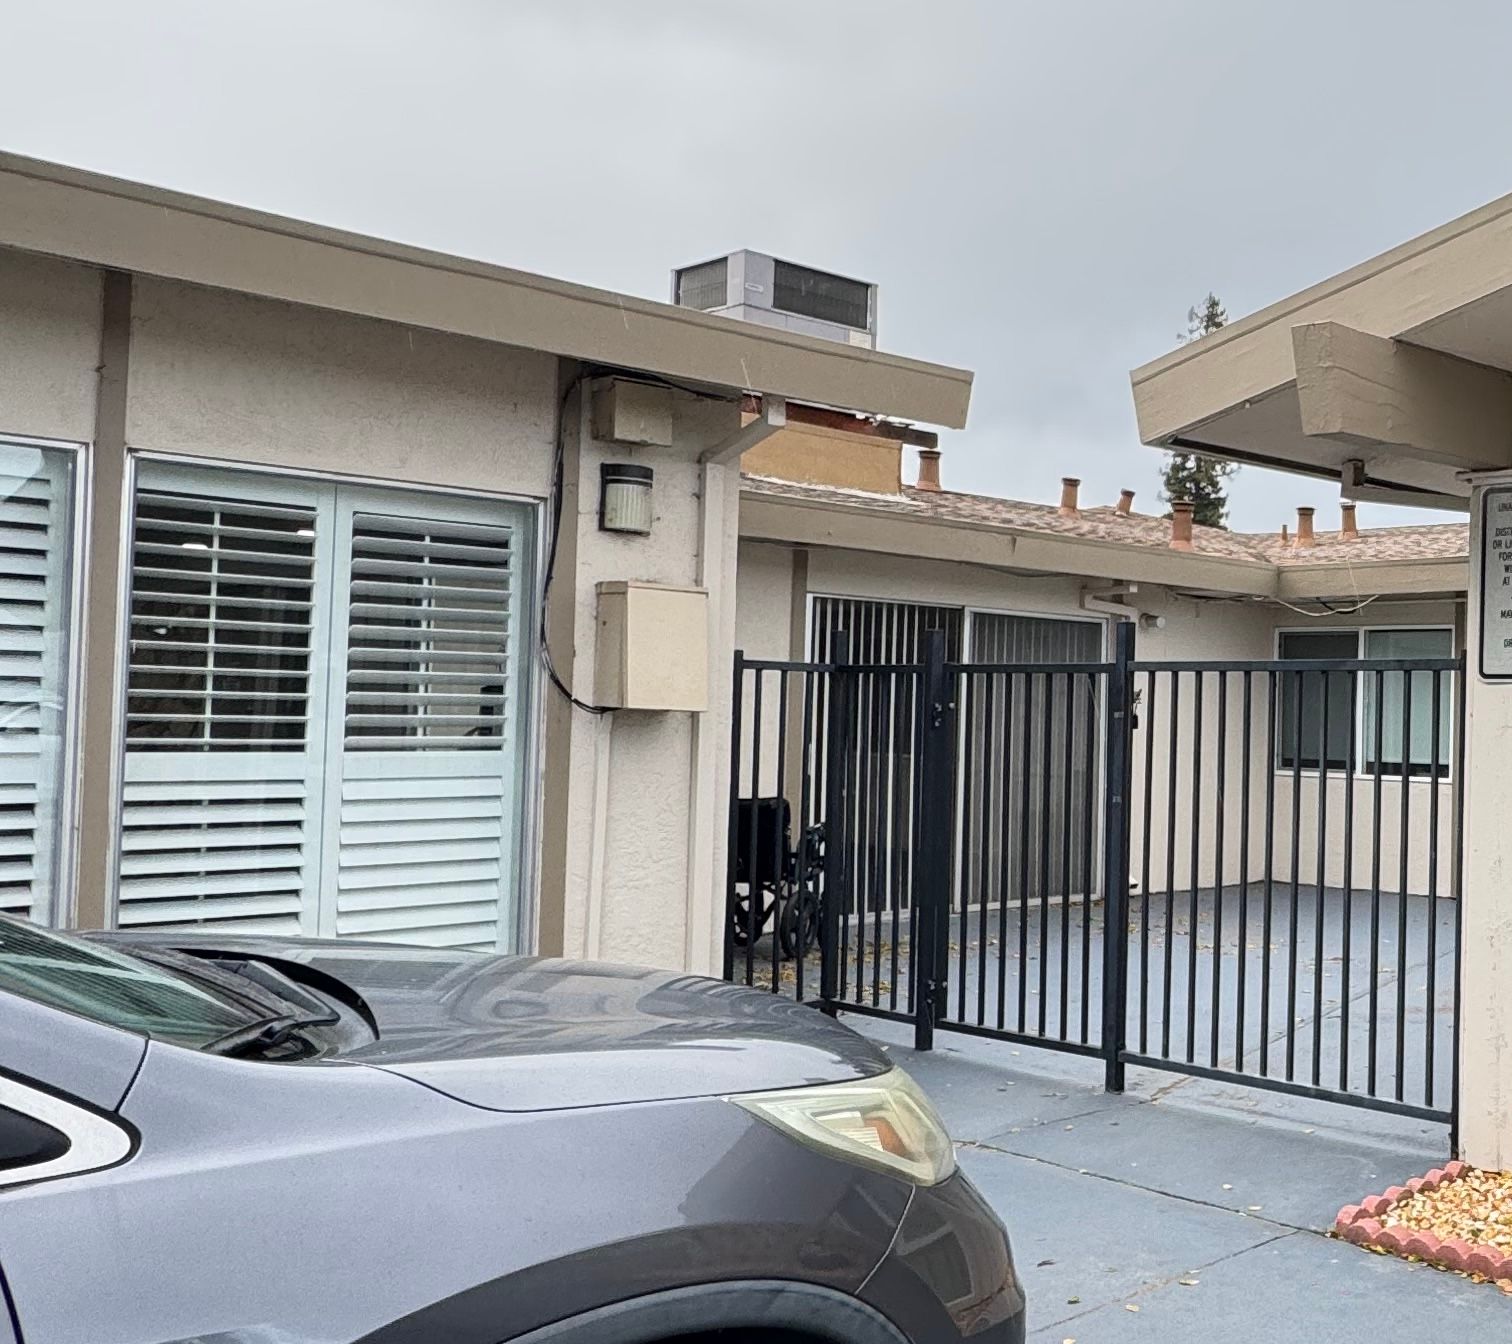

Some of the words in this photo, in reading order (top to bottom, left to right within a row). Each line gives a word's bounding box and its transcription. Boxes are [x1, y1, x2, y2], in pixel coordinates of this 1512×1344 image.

[1493, 539, 1502, 549] OR
[1499, 551, 1512, 561] FOR
[1502, 576, 1510, 586] AT
[1504, 639, 1512, 648] OR
